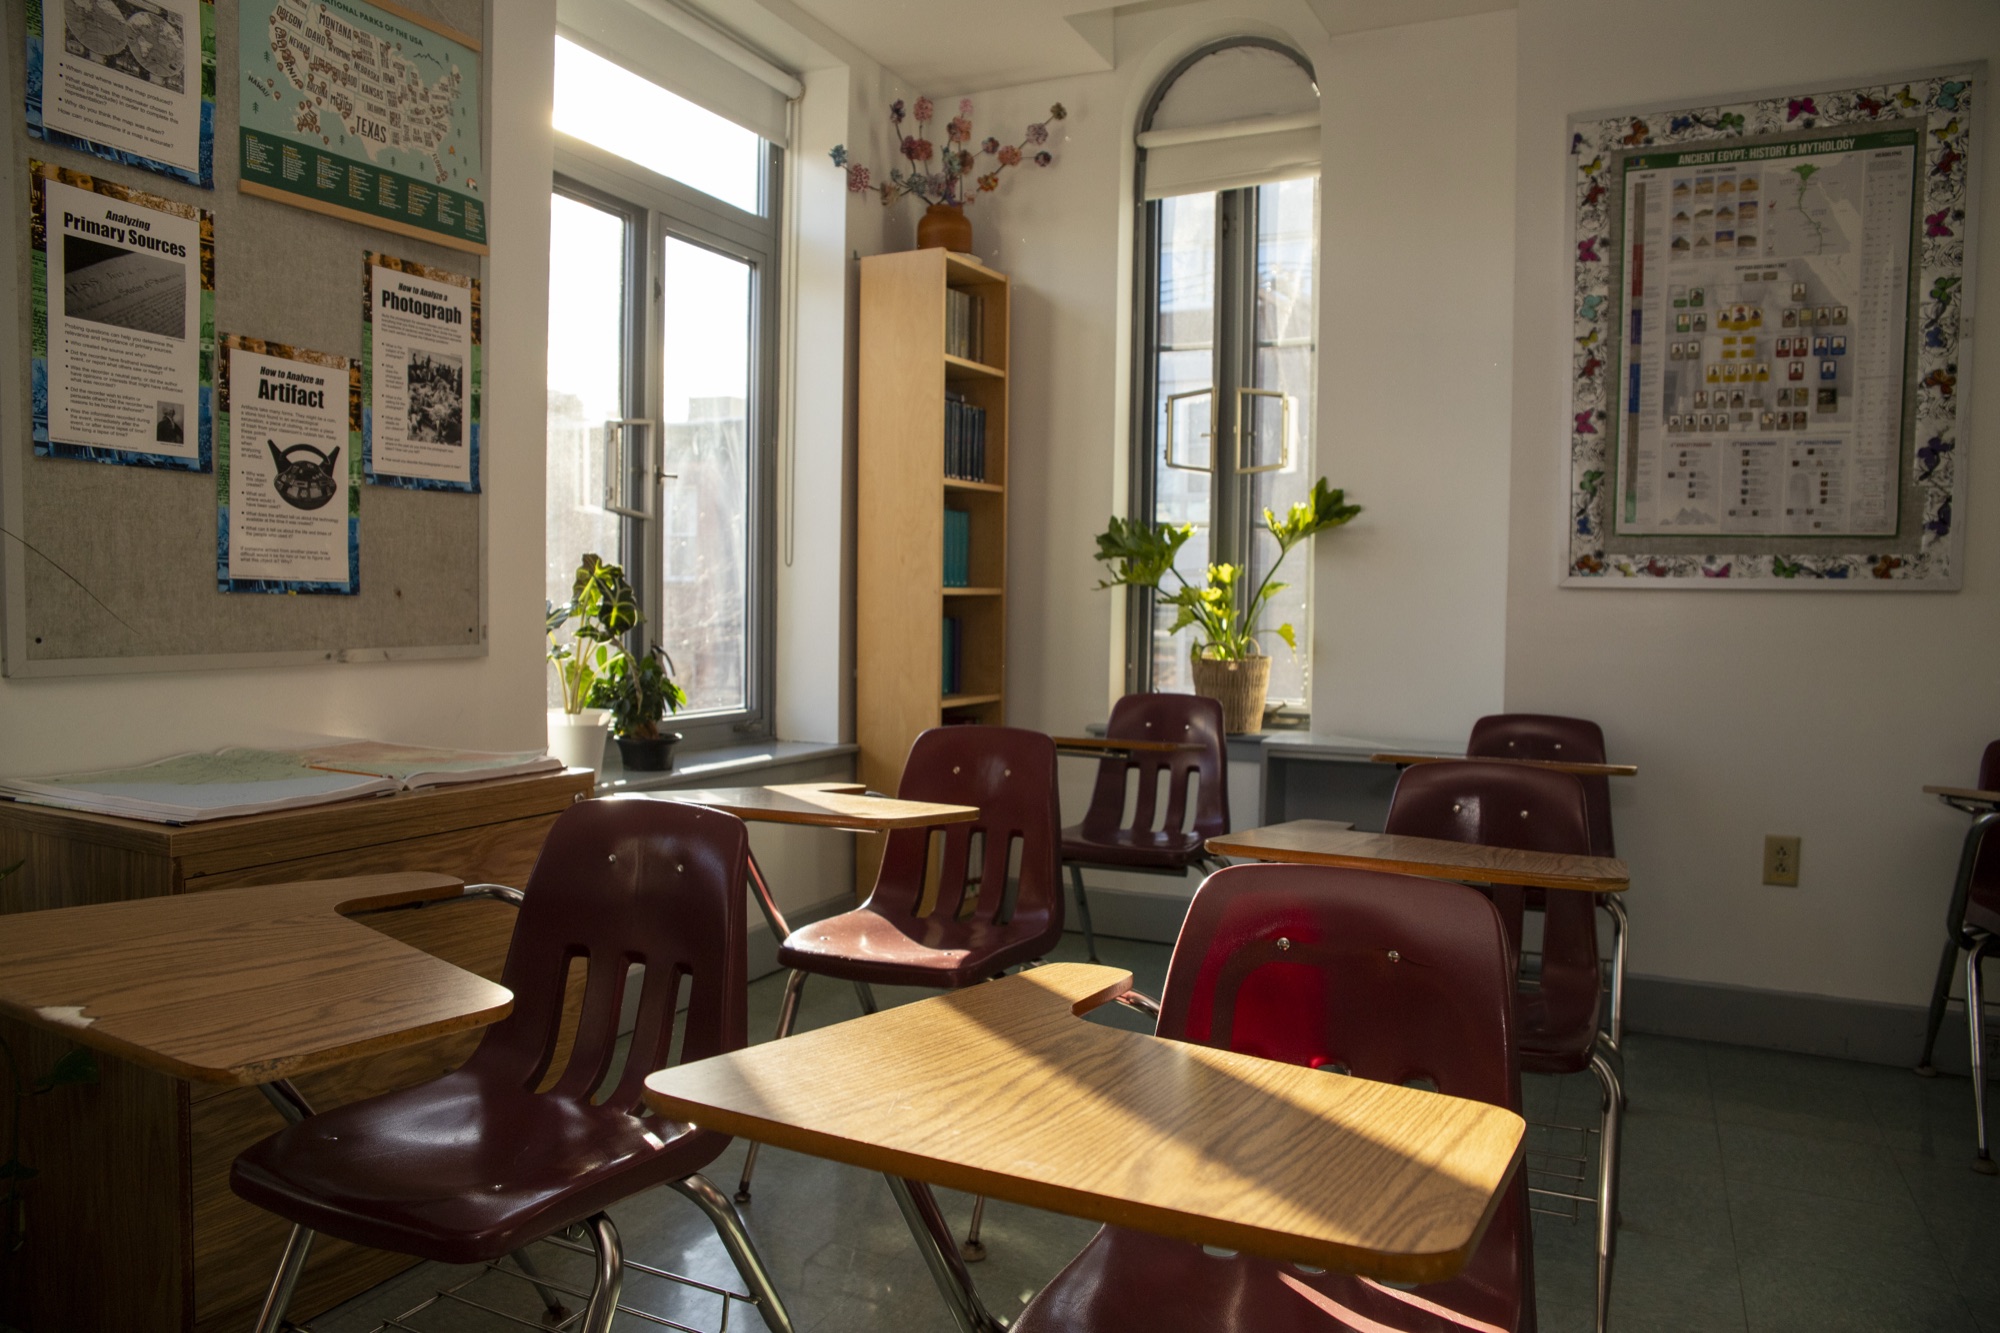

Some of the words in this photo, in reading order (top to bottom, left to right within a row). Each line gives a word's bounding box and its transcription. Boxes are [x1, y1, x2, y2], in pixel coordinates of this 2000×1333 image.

[276, 5, 303, 30] OREGON
[319, 13, 352, 40] MONTANA
[321, 0, 358, 17] ATIONAL
[359, 11, 383, 28] PARKS
[384, 23, 394, 33] OF
[395, 28, 408, 40] THE
[409, 35, 423, 47] USA
[288, 35, 310, 55] NEVADA
[305, 27, 326, 46] IDAHO
[328, 43, 351, 62] WYOMING
[354, 61, 380, 83] NEBRASKA
[383, 72, 395, 86] IOWA
[64, 88, 107, 106] representation?
[65, 64, 83, 74] When
[83, 71, 95, 79] and
[96, 76, 112, 85] where
[125, 85, 134, 93] the
[135, 89, 146, 97] map
[147, 94, 173, 106] produced?
[65, 75, 80, 85] What
[81, 81, 99, 92] details
[100, 87, 111, 95] has
[111, 91, 121, 99] the
[121, 95, 148, 108] mapmaker
[149, 105, 168, 115] chosen
[248, 75, 270, 97] HAWAII
[361, 80, 384, 101] KANSAS
[65, 81, 85, 93] include
[95, 93, 118, 105] exclude)
[125, 103, 139, 111] order
[146, 110, 169, 121] complete
[169, 117, 179, 125] this
[57, 107, 71, 116] How
[71, 112, 82, 120] can
[94, 120, 121, 132] determine
[132, 132, 143, 140] map
[149, 138, 174, 148] accurate?
[65, 98, 77, 108] Why
[98, 110, 111, 119] think
[122, 118, 134, 126] map
[146, 126, 165, 135] drawn?
[356, 115, 387, 143] TEXAS
[1678, 152, 1715, 165] ANCIENT
[1717, 149, 1748, 162] EGYPT:
[1750, 145, 1788, 159] HISTORY
[1790, 144, 1797, 155] &
[1798, 138, 1856, 154] MYTHOLOGY
[105, 210, 151, 231] Analyzing
[64, 212, 125, 243] Primary
[129, 230, 186, 258] Sources
[398, 283, 411, 293] How
[412, 287, 419, 295] to
[420, 288, 443, 300] Analyze
[382, 290, 462, 324] Photograph
[65, 322, 85, 332] Probing
[86, 327, 110, 336] questions
[121, 333, 131, 341] help
[142, 338, 165, 347] determine
[65, 330, 90, 339] relevance
[101, 337, 128, 346] importance
[135, 343, 153, 351] primary
[93, 380, 116, 388] recorded?
[260, 366, 276, 377] How
[278, 370, 285, 379] to
[286, 371, 314, 384] Analyze
[315, 378, 324, 386] an
[258, 378, 324, 409] Artifact
